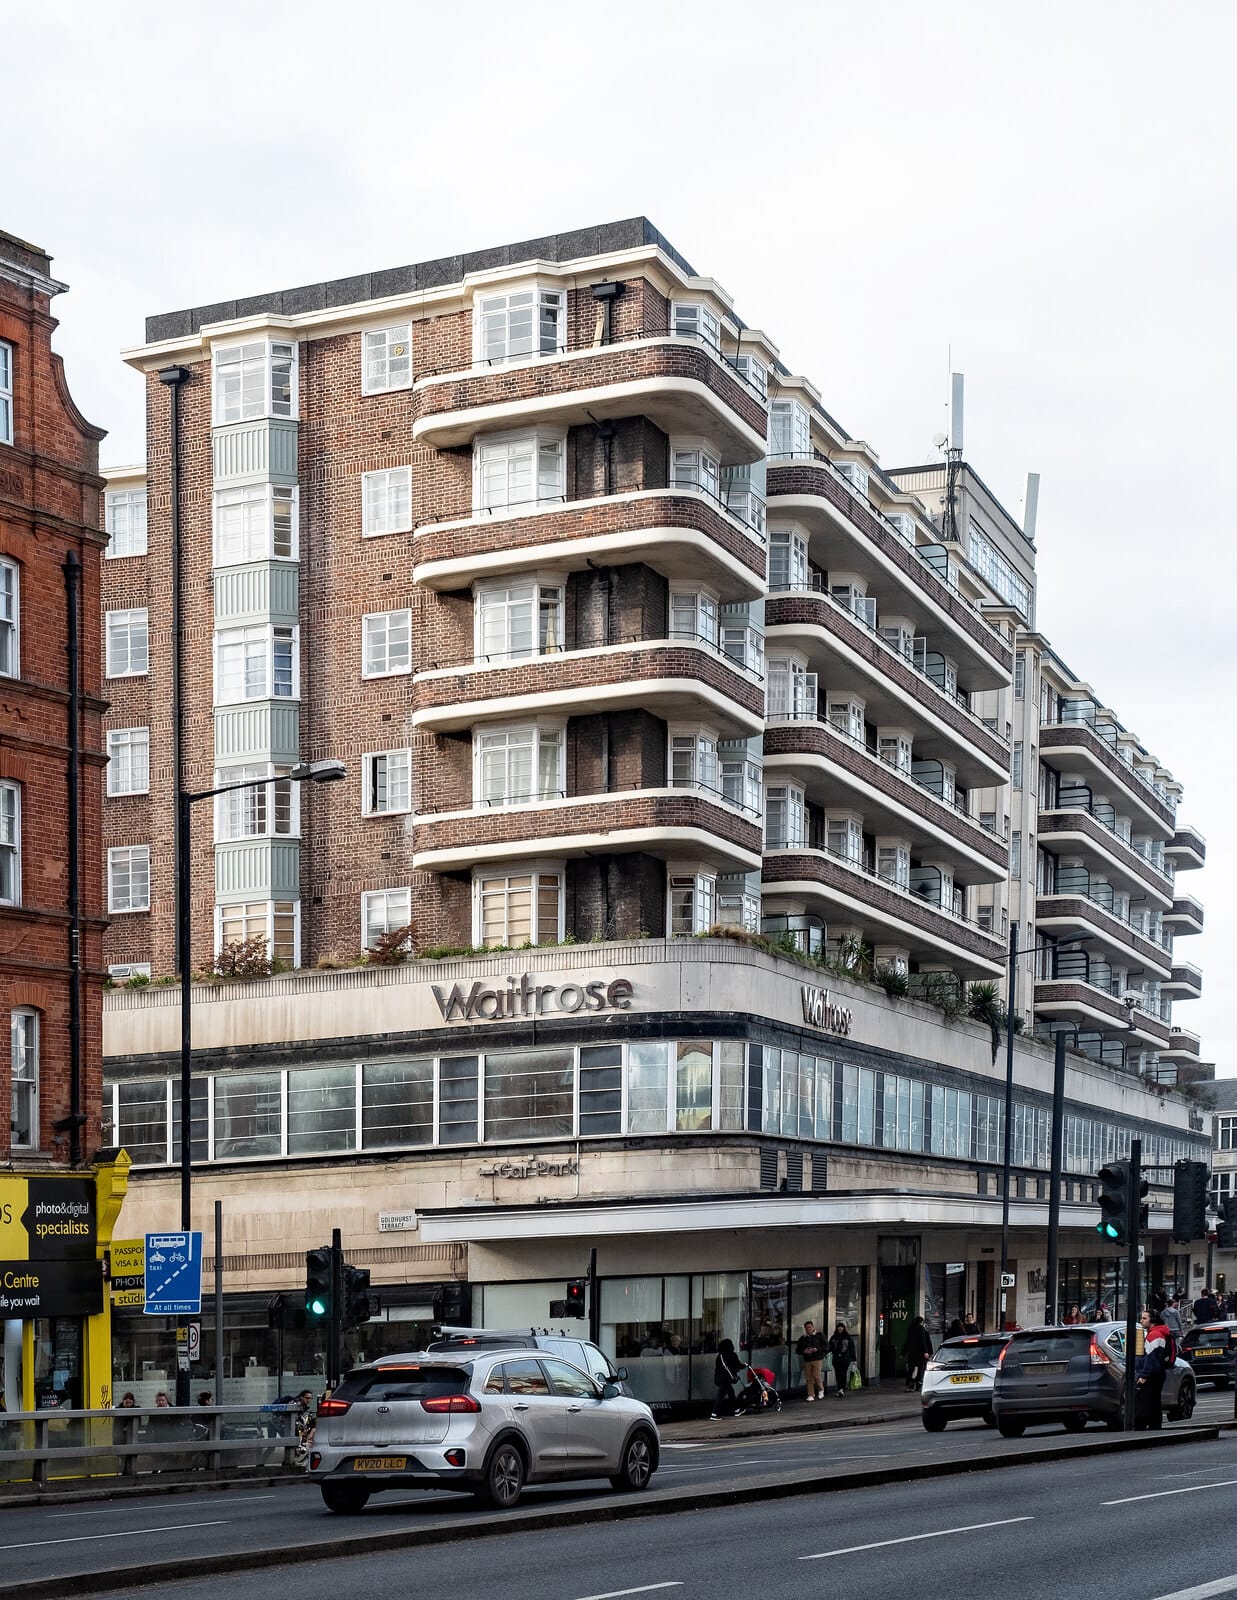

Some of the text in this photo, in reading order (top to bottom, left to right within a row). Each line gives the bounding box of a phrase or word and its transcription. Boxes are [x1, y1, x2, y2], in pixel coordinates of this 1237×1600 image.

[431, 972, 634, 1023] Waitrose
[35, 1201, 89, 1217] photo&digital
[35, 1219, 90, 1239] specialists
[4, 1271, 40, 1289] Centre
[9, 1297, 24, 1311] you
[24, 1294, 41, 1306] wait
[154, 1303, 192, 1311] At all times
[892, 1299, 906, 1308] xit
[890, 1310, 908, 1321] nly
